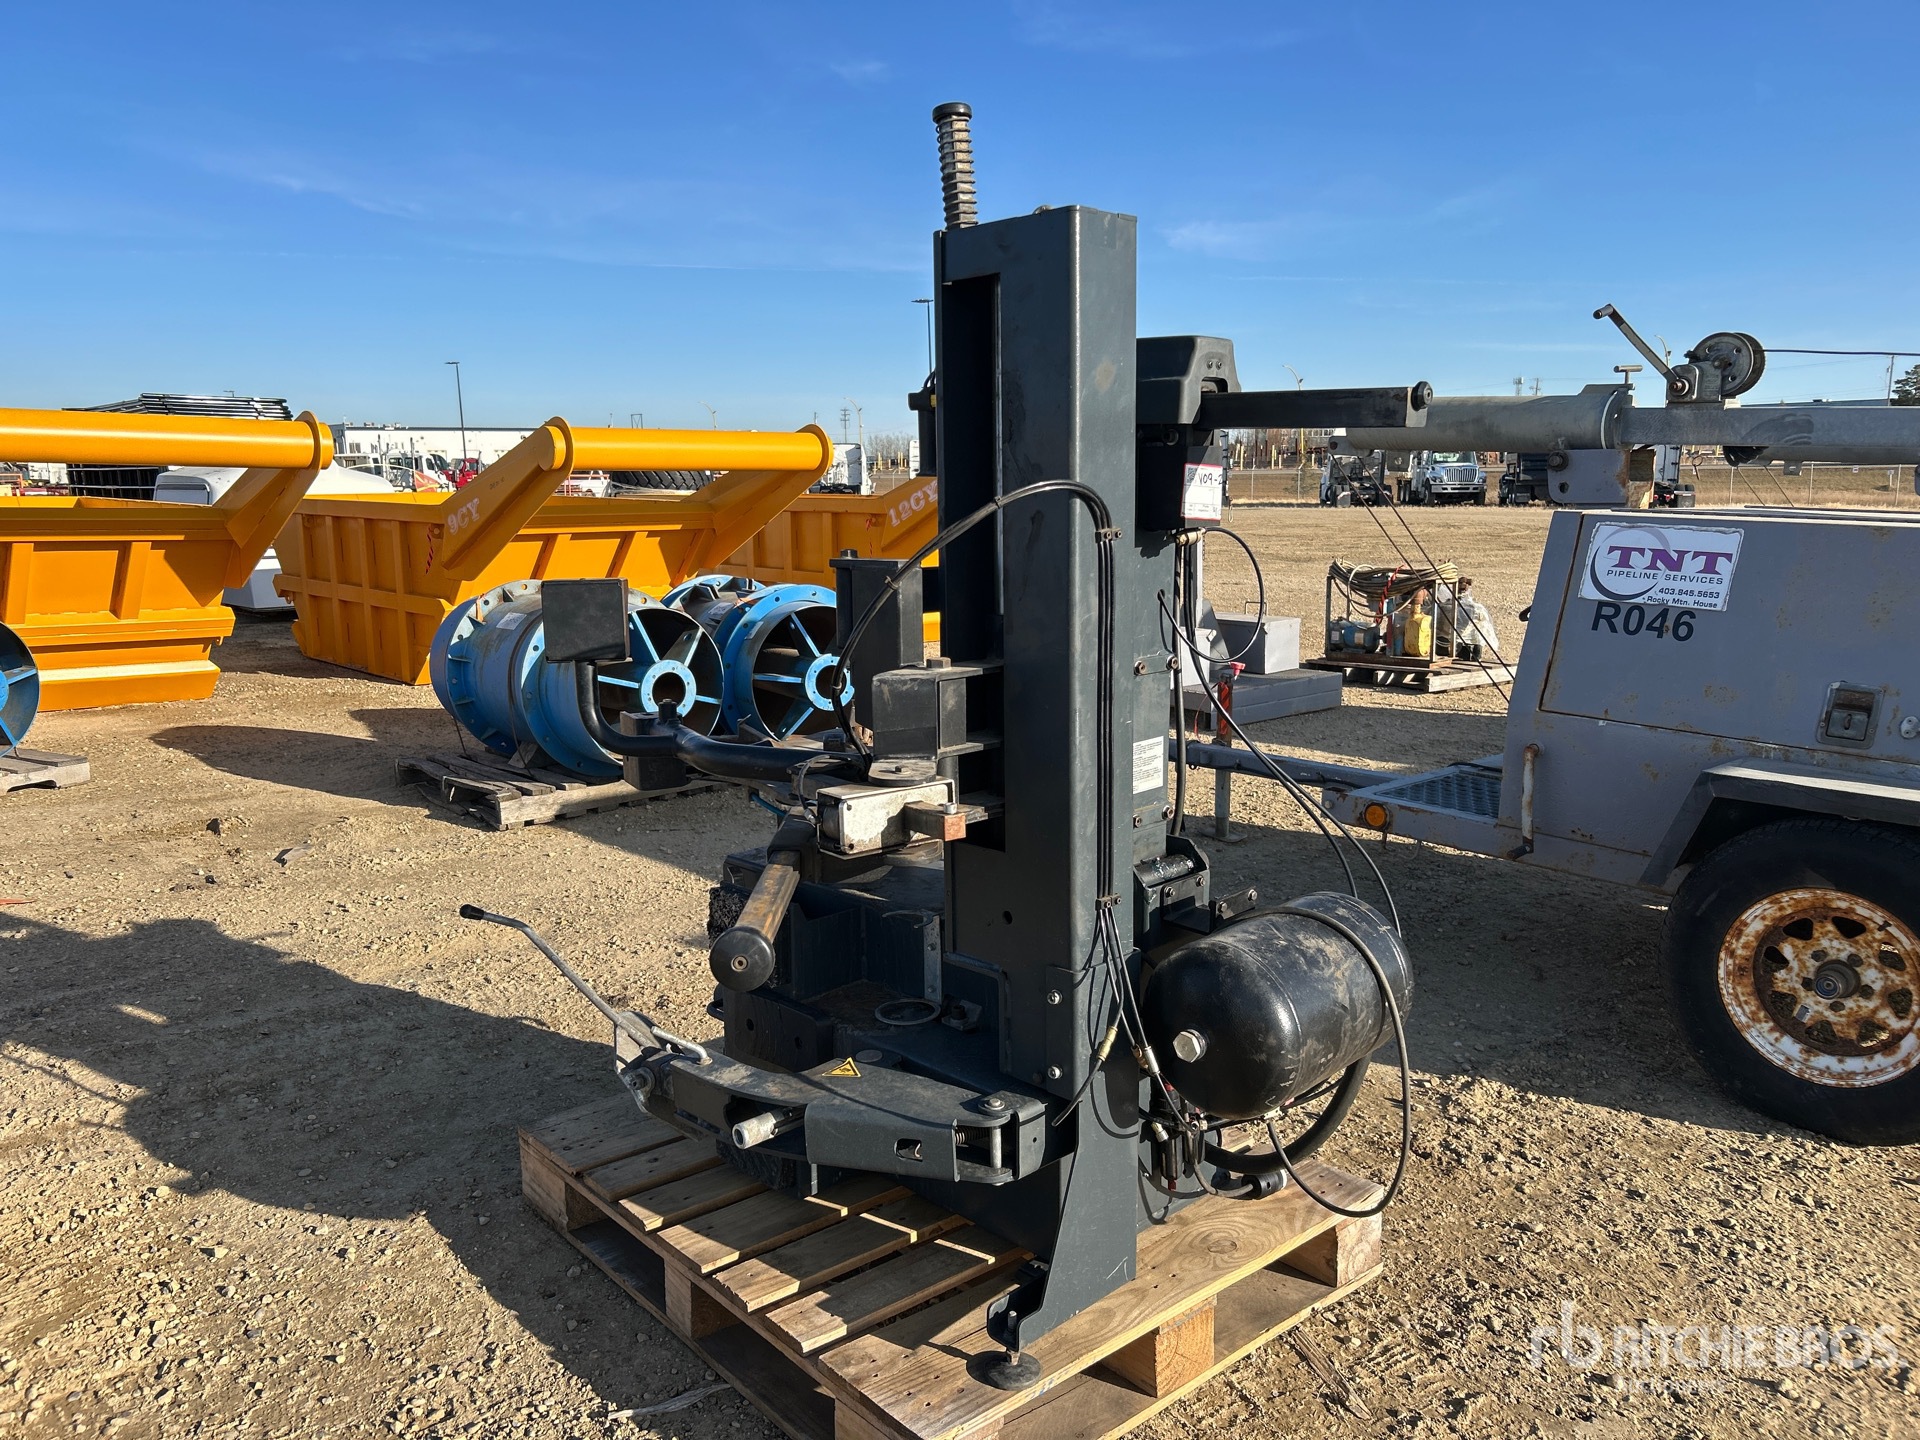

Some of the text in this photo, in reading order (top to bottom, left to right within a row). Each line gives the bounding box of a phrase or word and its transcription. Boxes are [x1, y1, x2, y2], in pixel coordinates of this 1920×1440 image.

[447, 497, 480, 535] 9CY
[888, 479, 938, 528] 12CY
[1606, 545, 1734, 576] TNT
[1606, 569, 1724, 585] PIPELINE SERVICES
[1646, 595, 1718, 609] Rocky Mtn. House
[1658, 587, 1720, 599] 403.845.5653
[1591, 601, 1697, 642] R046
